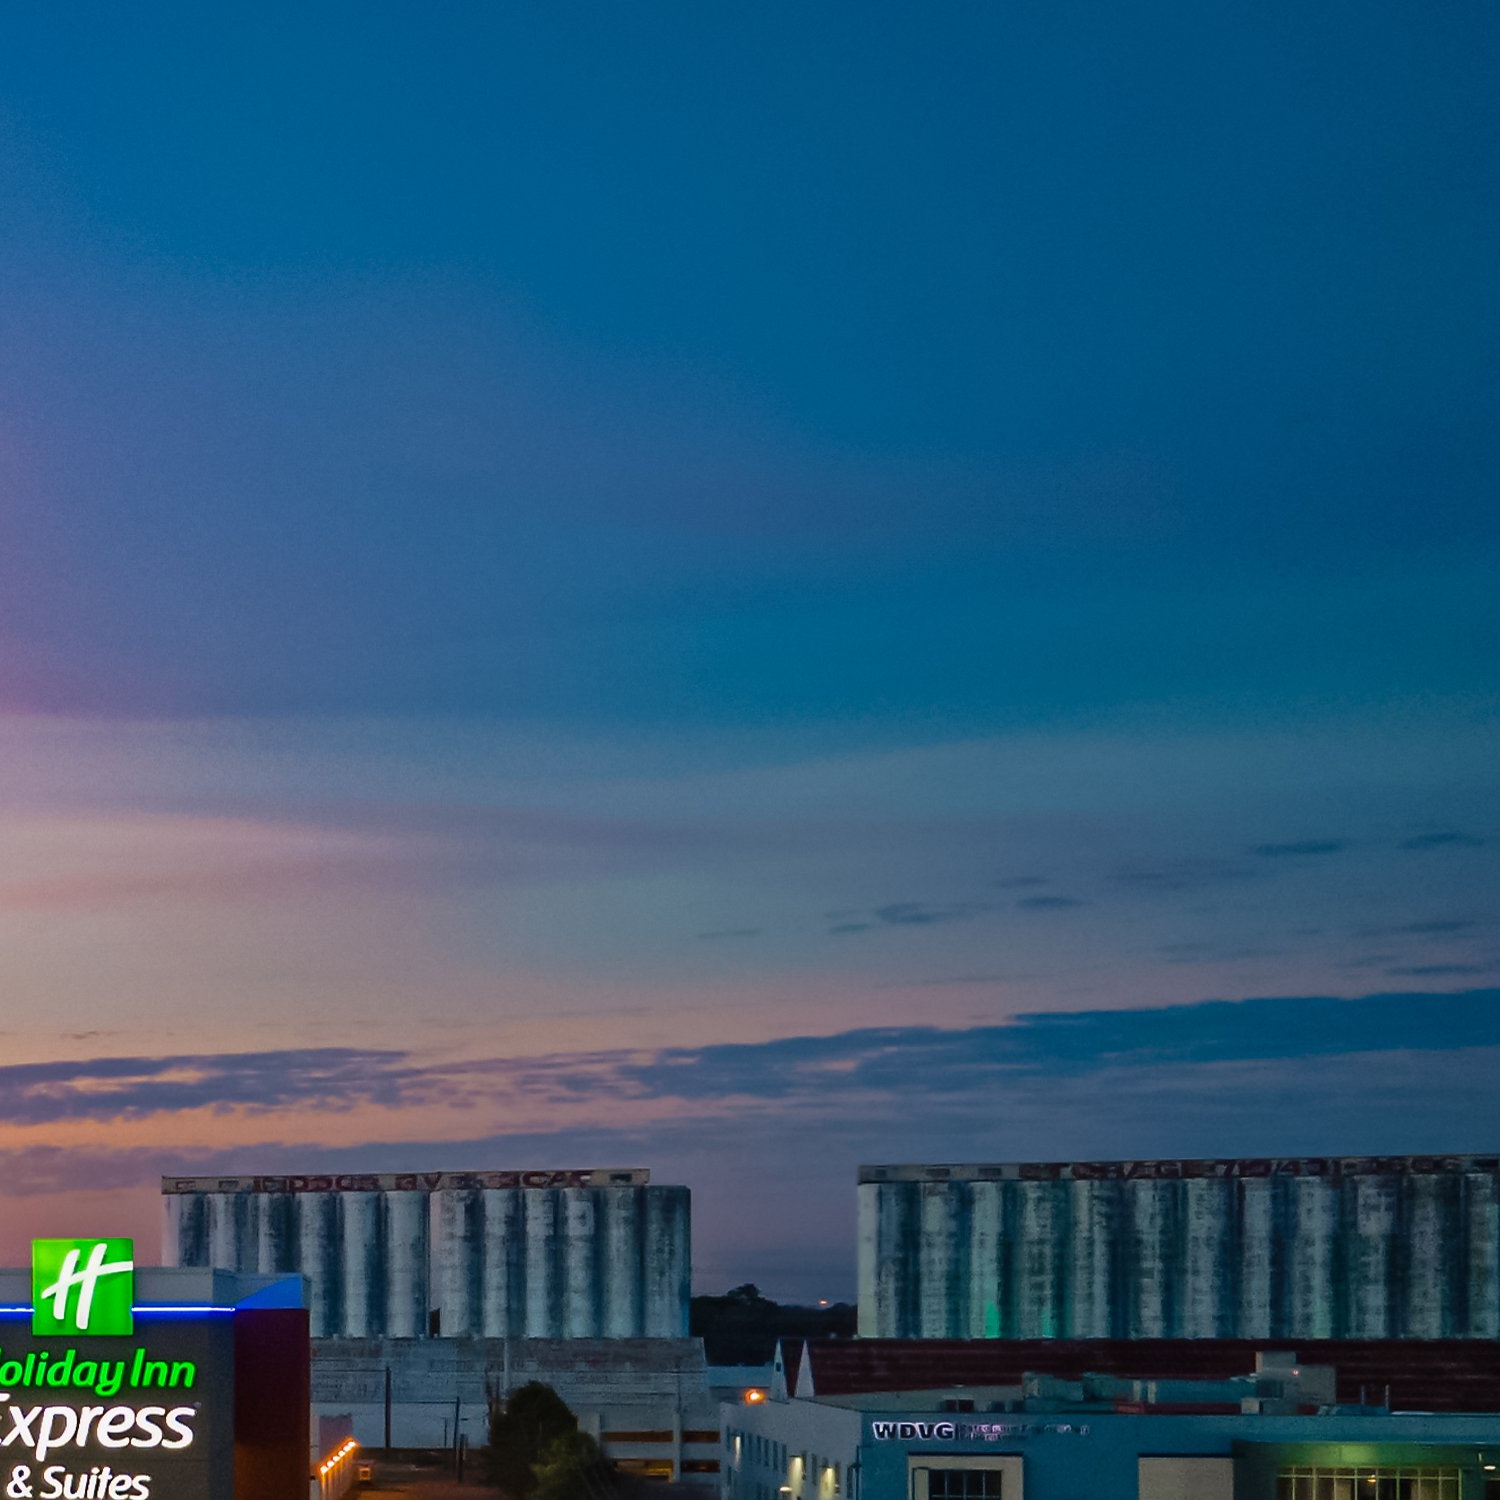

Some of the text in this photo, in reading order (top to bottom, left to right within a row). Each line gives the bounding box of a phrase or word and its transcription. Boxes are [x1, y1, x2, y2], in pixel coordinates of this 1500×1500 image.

[130, 1347, 197, 1388] Inn
[872, 1421, 955, 1441] WDVG
[5, 1464, 33, 1499] &
